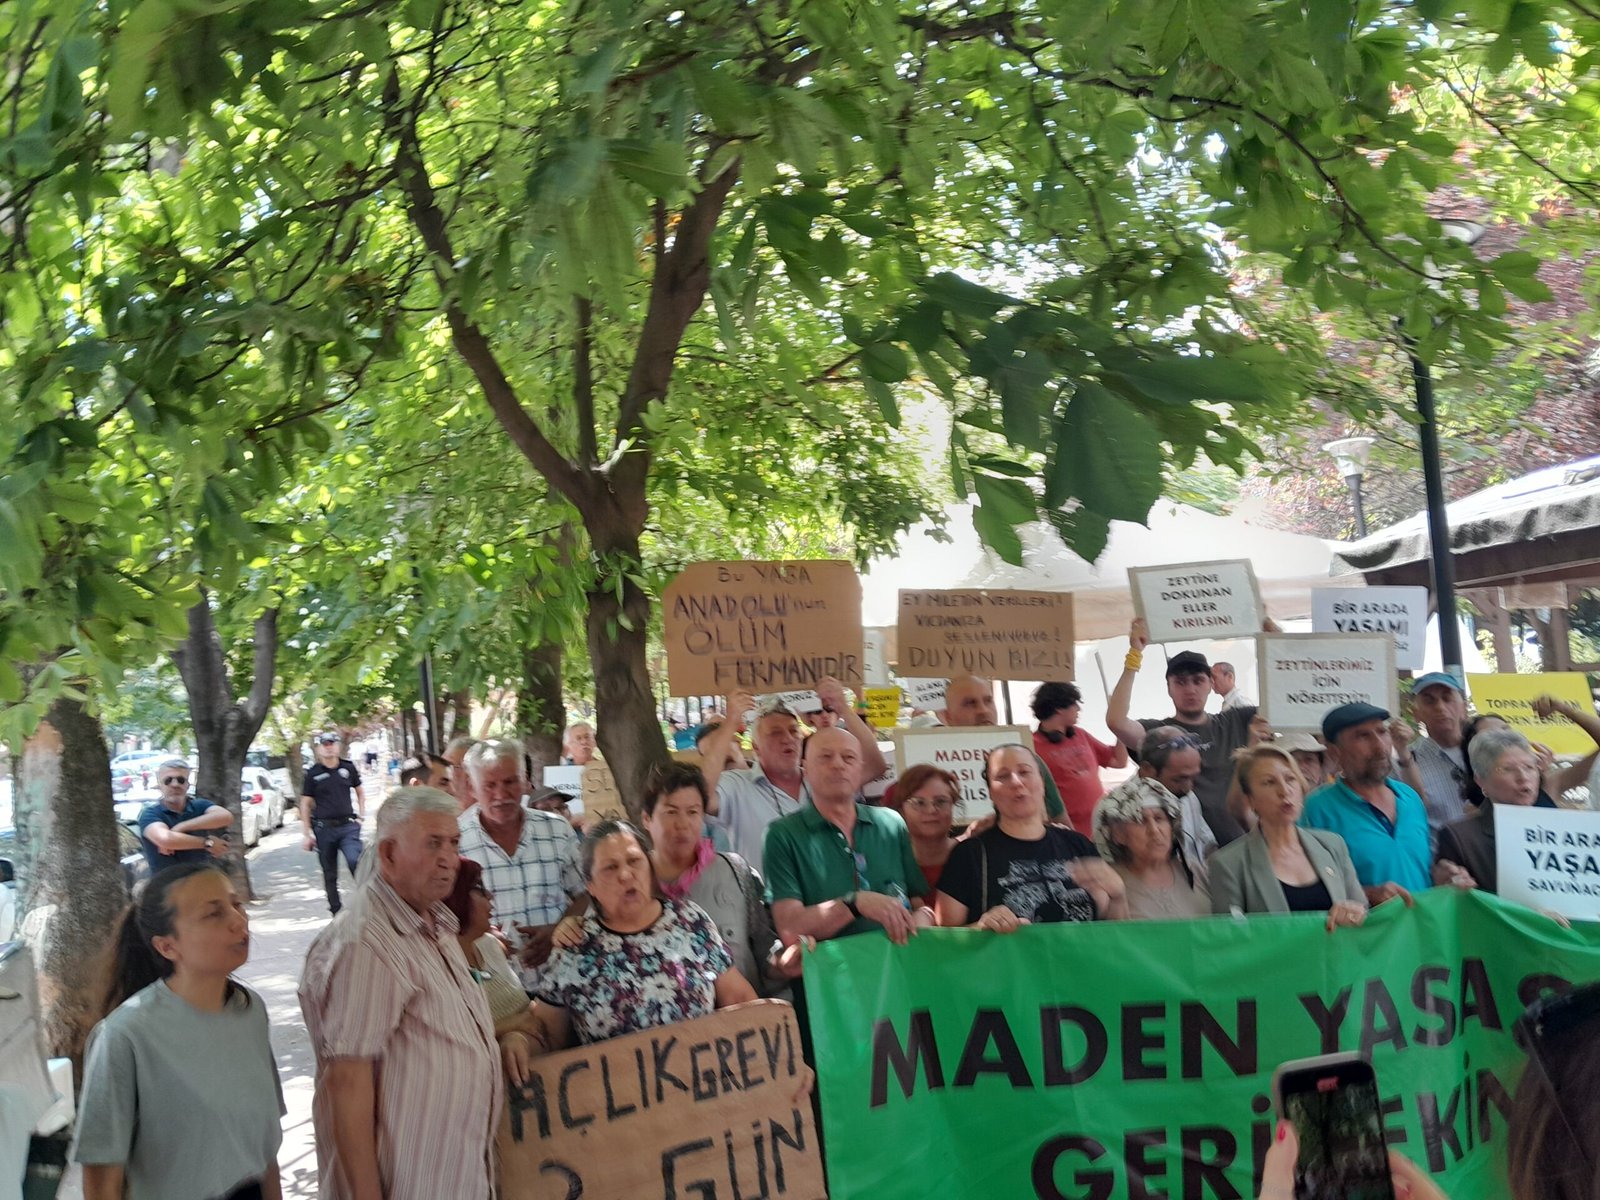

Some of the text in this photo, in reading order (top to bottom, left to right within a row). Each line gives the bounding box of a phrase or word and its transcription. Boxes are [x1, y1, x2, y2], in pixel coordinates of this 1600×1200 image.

[1166, 572, 1220, 587] ZEYTİNE
[1160, 586, 1232, 601] DOKUNAN
[1181, 601, 1218, 613] ELLER
[1361, 602, 1409, 615] ARADA
[908, 645, 996, 672] DUYUN
[1524, 825, 1558, 846] BİR
[869, 996, 1258, 1110] MADEN
[660, 1107, 806, 1200] GÜN
[1031, 1091, 1272, 1200] GERİ
